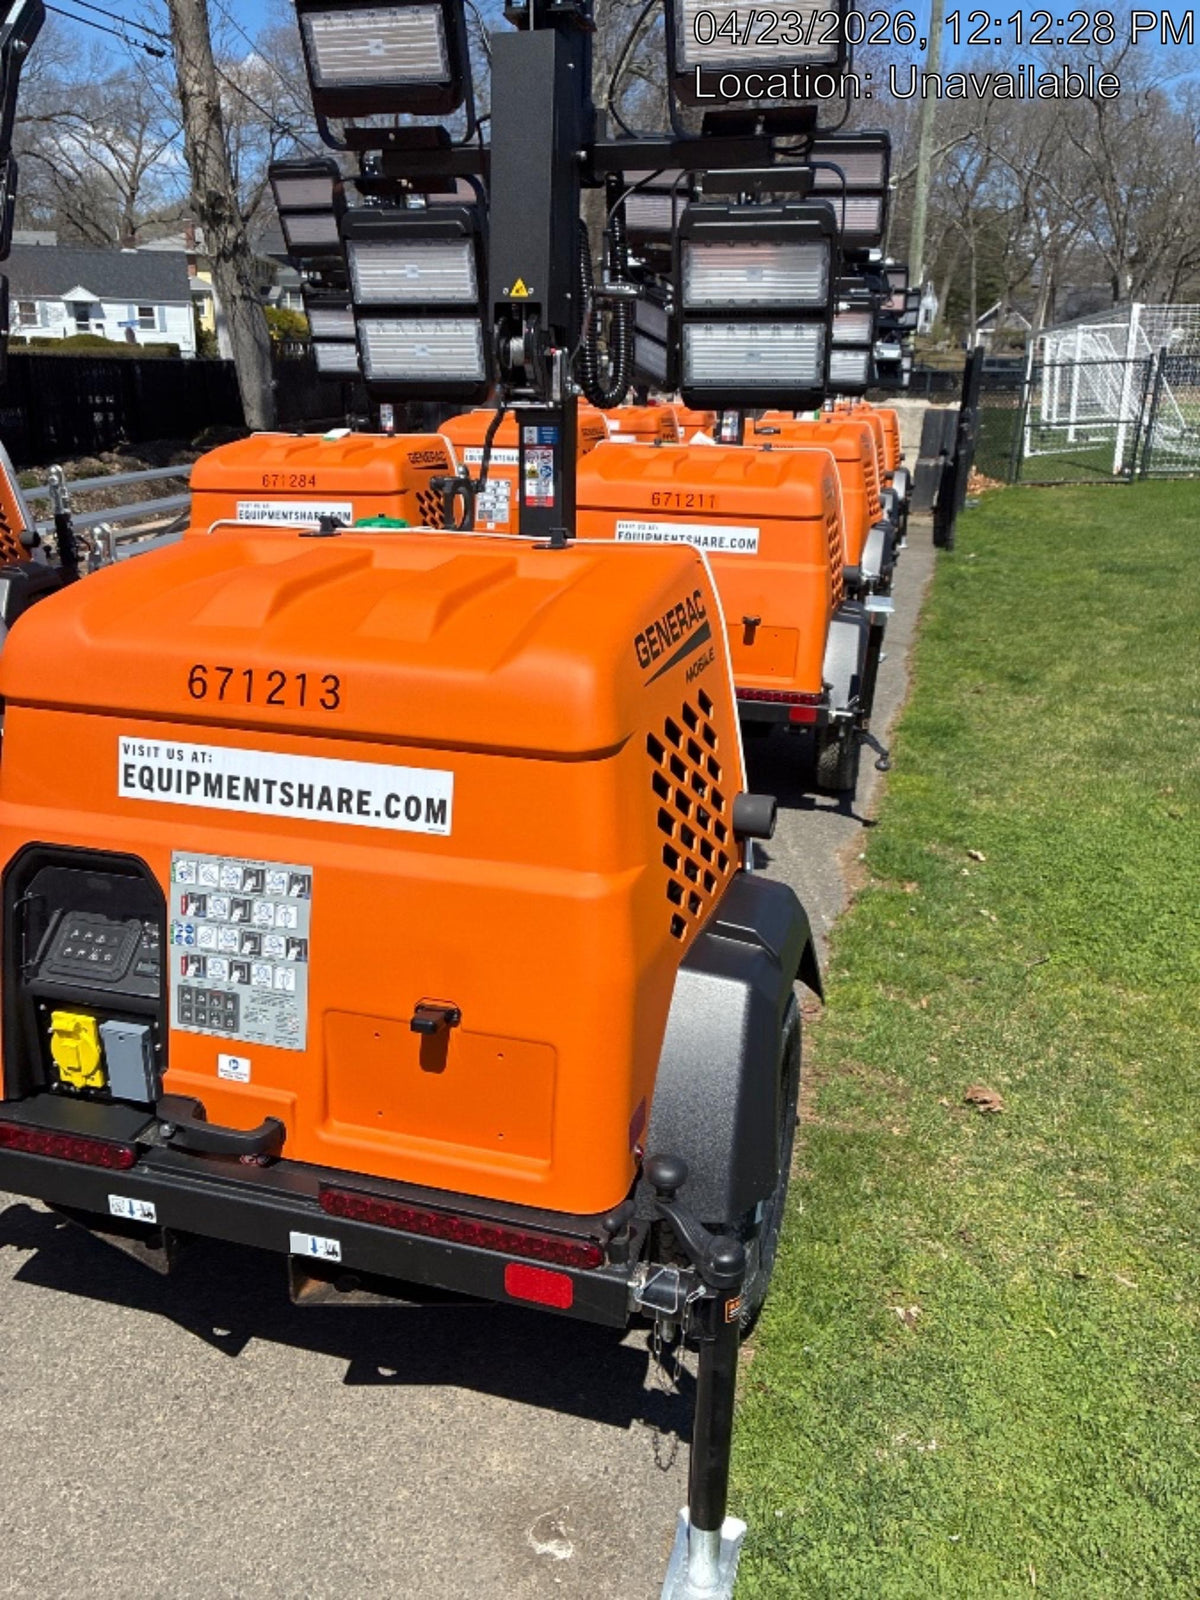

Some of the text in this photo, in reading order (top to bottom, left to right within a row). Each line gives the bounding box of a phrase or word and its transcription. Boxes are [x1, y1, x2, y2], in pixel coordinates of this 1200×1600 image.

[262, 474, 316, 488] 671284
[651, 491, 716, 508] 671211
[634, 589, 706, 669] GENERAC
[187, 664, 341, 710] 671213
[122, 743, 212, 763] VISIT US AT:
[123, 762, 448, 825] EQUIPMENTSHARE.COM
